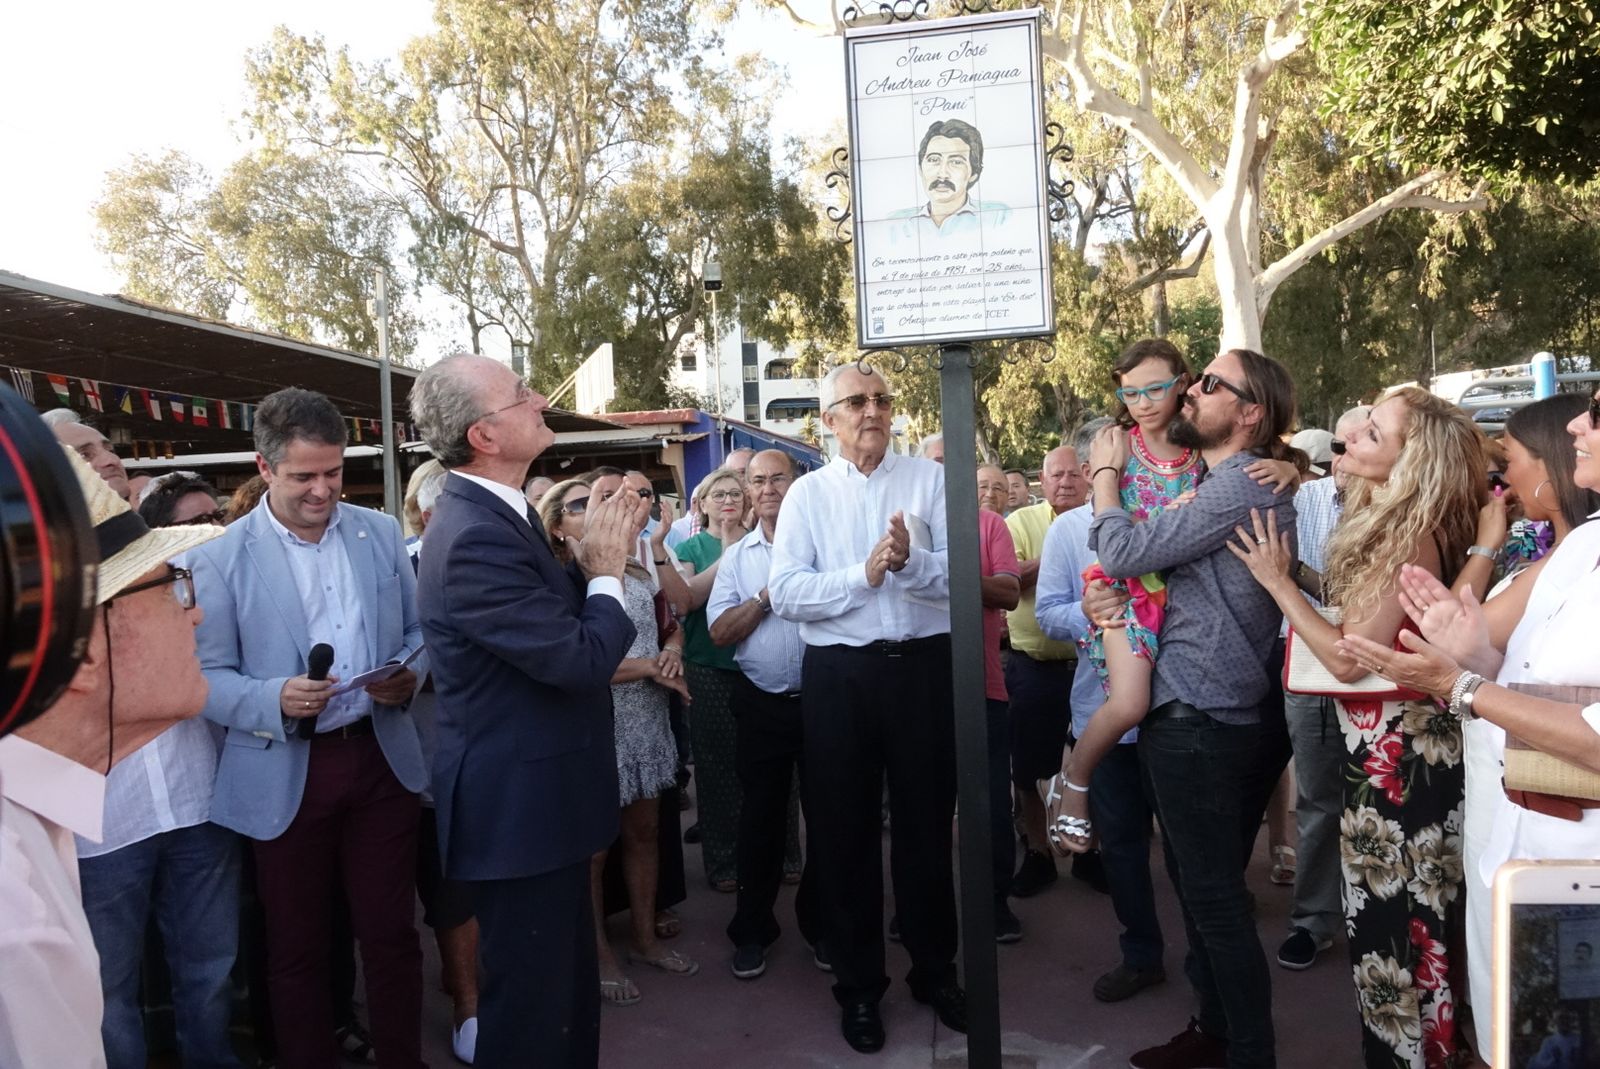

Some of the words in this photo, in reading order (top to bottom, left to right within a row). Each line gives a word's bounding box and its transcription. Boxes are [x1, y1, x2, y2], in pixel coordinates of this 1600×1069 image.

[896, 46, 942, 67] Juan
[948, 40, 988, 62] José
[865, 76, 931, 95] Andreu
[937, 68, 1021, 87] Paniagua
[892, 270, 898, 280] 9
[899, 271, 909, 279] de
